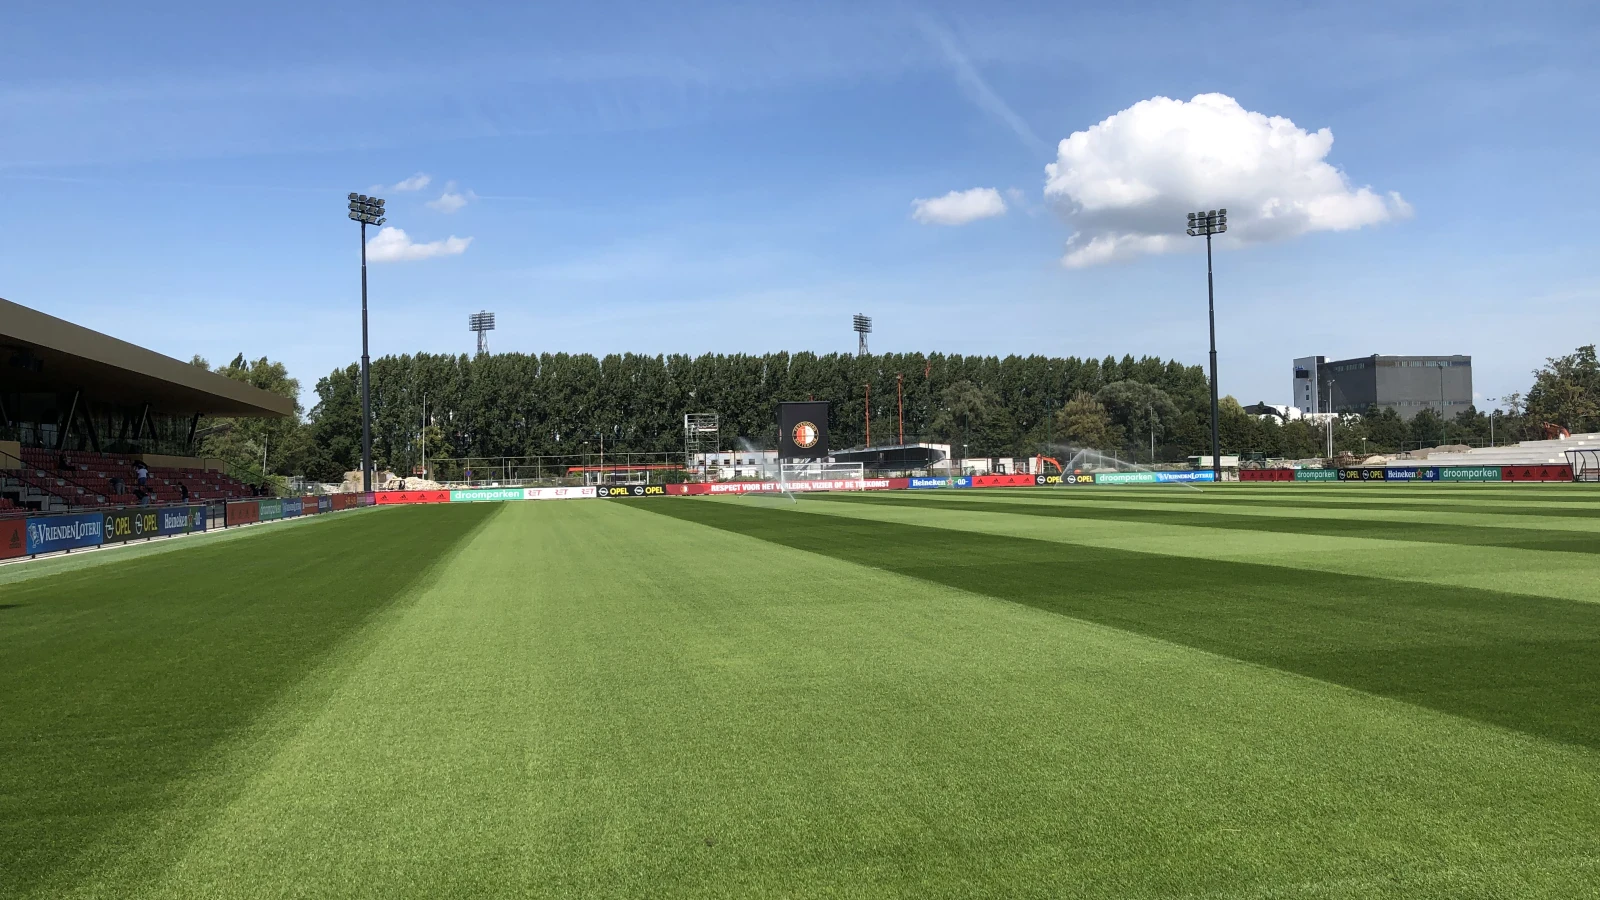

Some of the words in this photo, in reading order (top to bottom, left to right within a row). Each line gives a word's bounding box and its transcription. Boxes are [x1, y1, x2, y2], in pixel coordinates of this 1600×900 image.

[1099, 472, 1152, 483] droomparken
[1297, 469, 1335, 479] droomparken
[1347, 470, 1359, 479] OPEL
[1371, 470, 1383, 479] OPEL
[1387, 470, 1416, 478] Heineken
[1442, 469, 1498, 478] droomparken
[912, 479, 945, 487] Heineken
[1046, 475, 1063, 484] OPEL
[1077, 475, 1094, 483] OPEL
[711, 484, 741, 492] RESPECT
[742, 483, 761, 491] VOOR
[812, 481, 833, 489] VIZIER
[834, 481, 843, 489] OP
[454, 490, 520, 500] droomparken
[144, 514, 158, 532] OPEL
[164, 512, 188, 529] Heineken
[115, 516, 131, 535] OPEL
